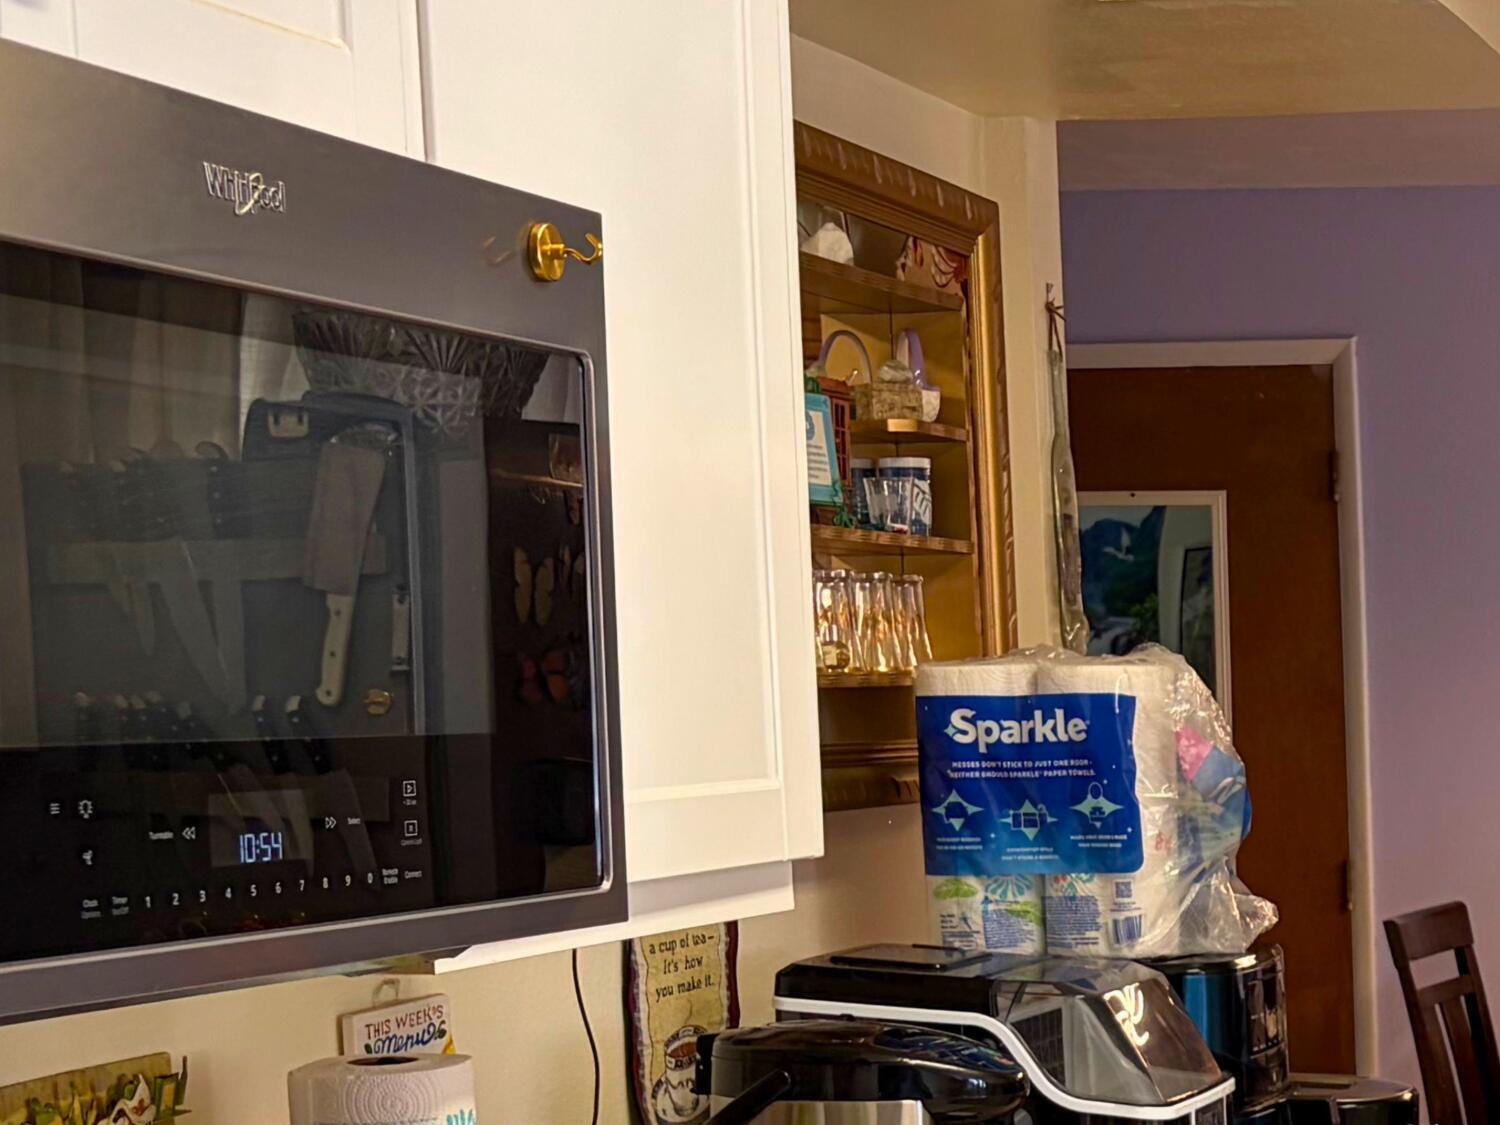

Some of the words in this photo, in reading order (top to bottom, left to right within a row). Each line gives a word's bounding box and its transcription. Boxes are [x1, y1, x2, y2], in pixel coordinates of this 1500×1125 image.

[950, 708, 1088, 753] Sparkle
[1002, 760, 1023, 768] STICK
[1024, 760, 1033, 768] TO
[1034, 760, 1052, 768] JUST
[1043, 769, 1067, 777] PAPER
[239, 831, 283, 863] 10:54
[145, 895, 151, 908] 1
[172, 893, 180, 906] 2
[199, 890, 206, 902] 3
[225, 887, 232, 899] 4
[250, 884, 257, 897] 5
[275, 882, 282, 894] 6
[299, 879, 305, 891] 7
[322, 877, 329, 889] 8
[345, 874, 351, 887] 9
[649, 943, 656, 955] a
[658, 940, 677, 956] cup
[680, 932, 691, 950] of
[684, 954, 704, 971] how
[655, 984, 675, 1003] you
[677, 976, 702, 994] make
[365, 1019, 393, 1040] THIS
[395, 1004, 445, 1030] WEEK'S
